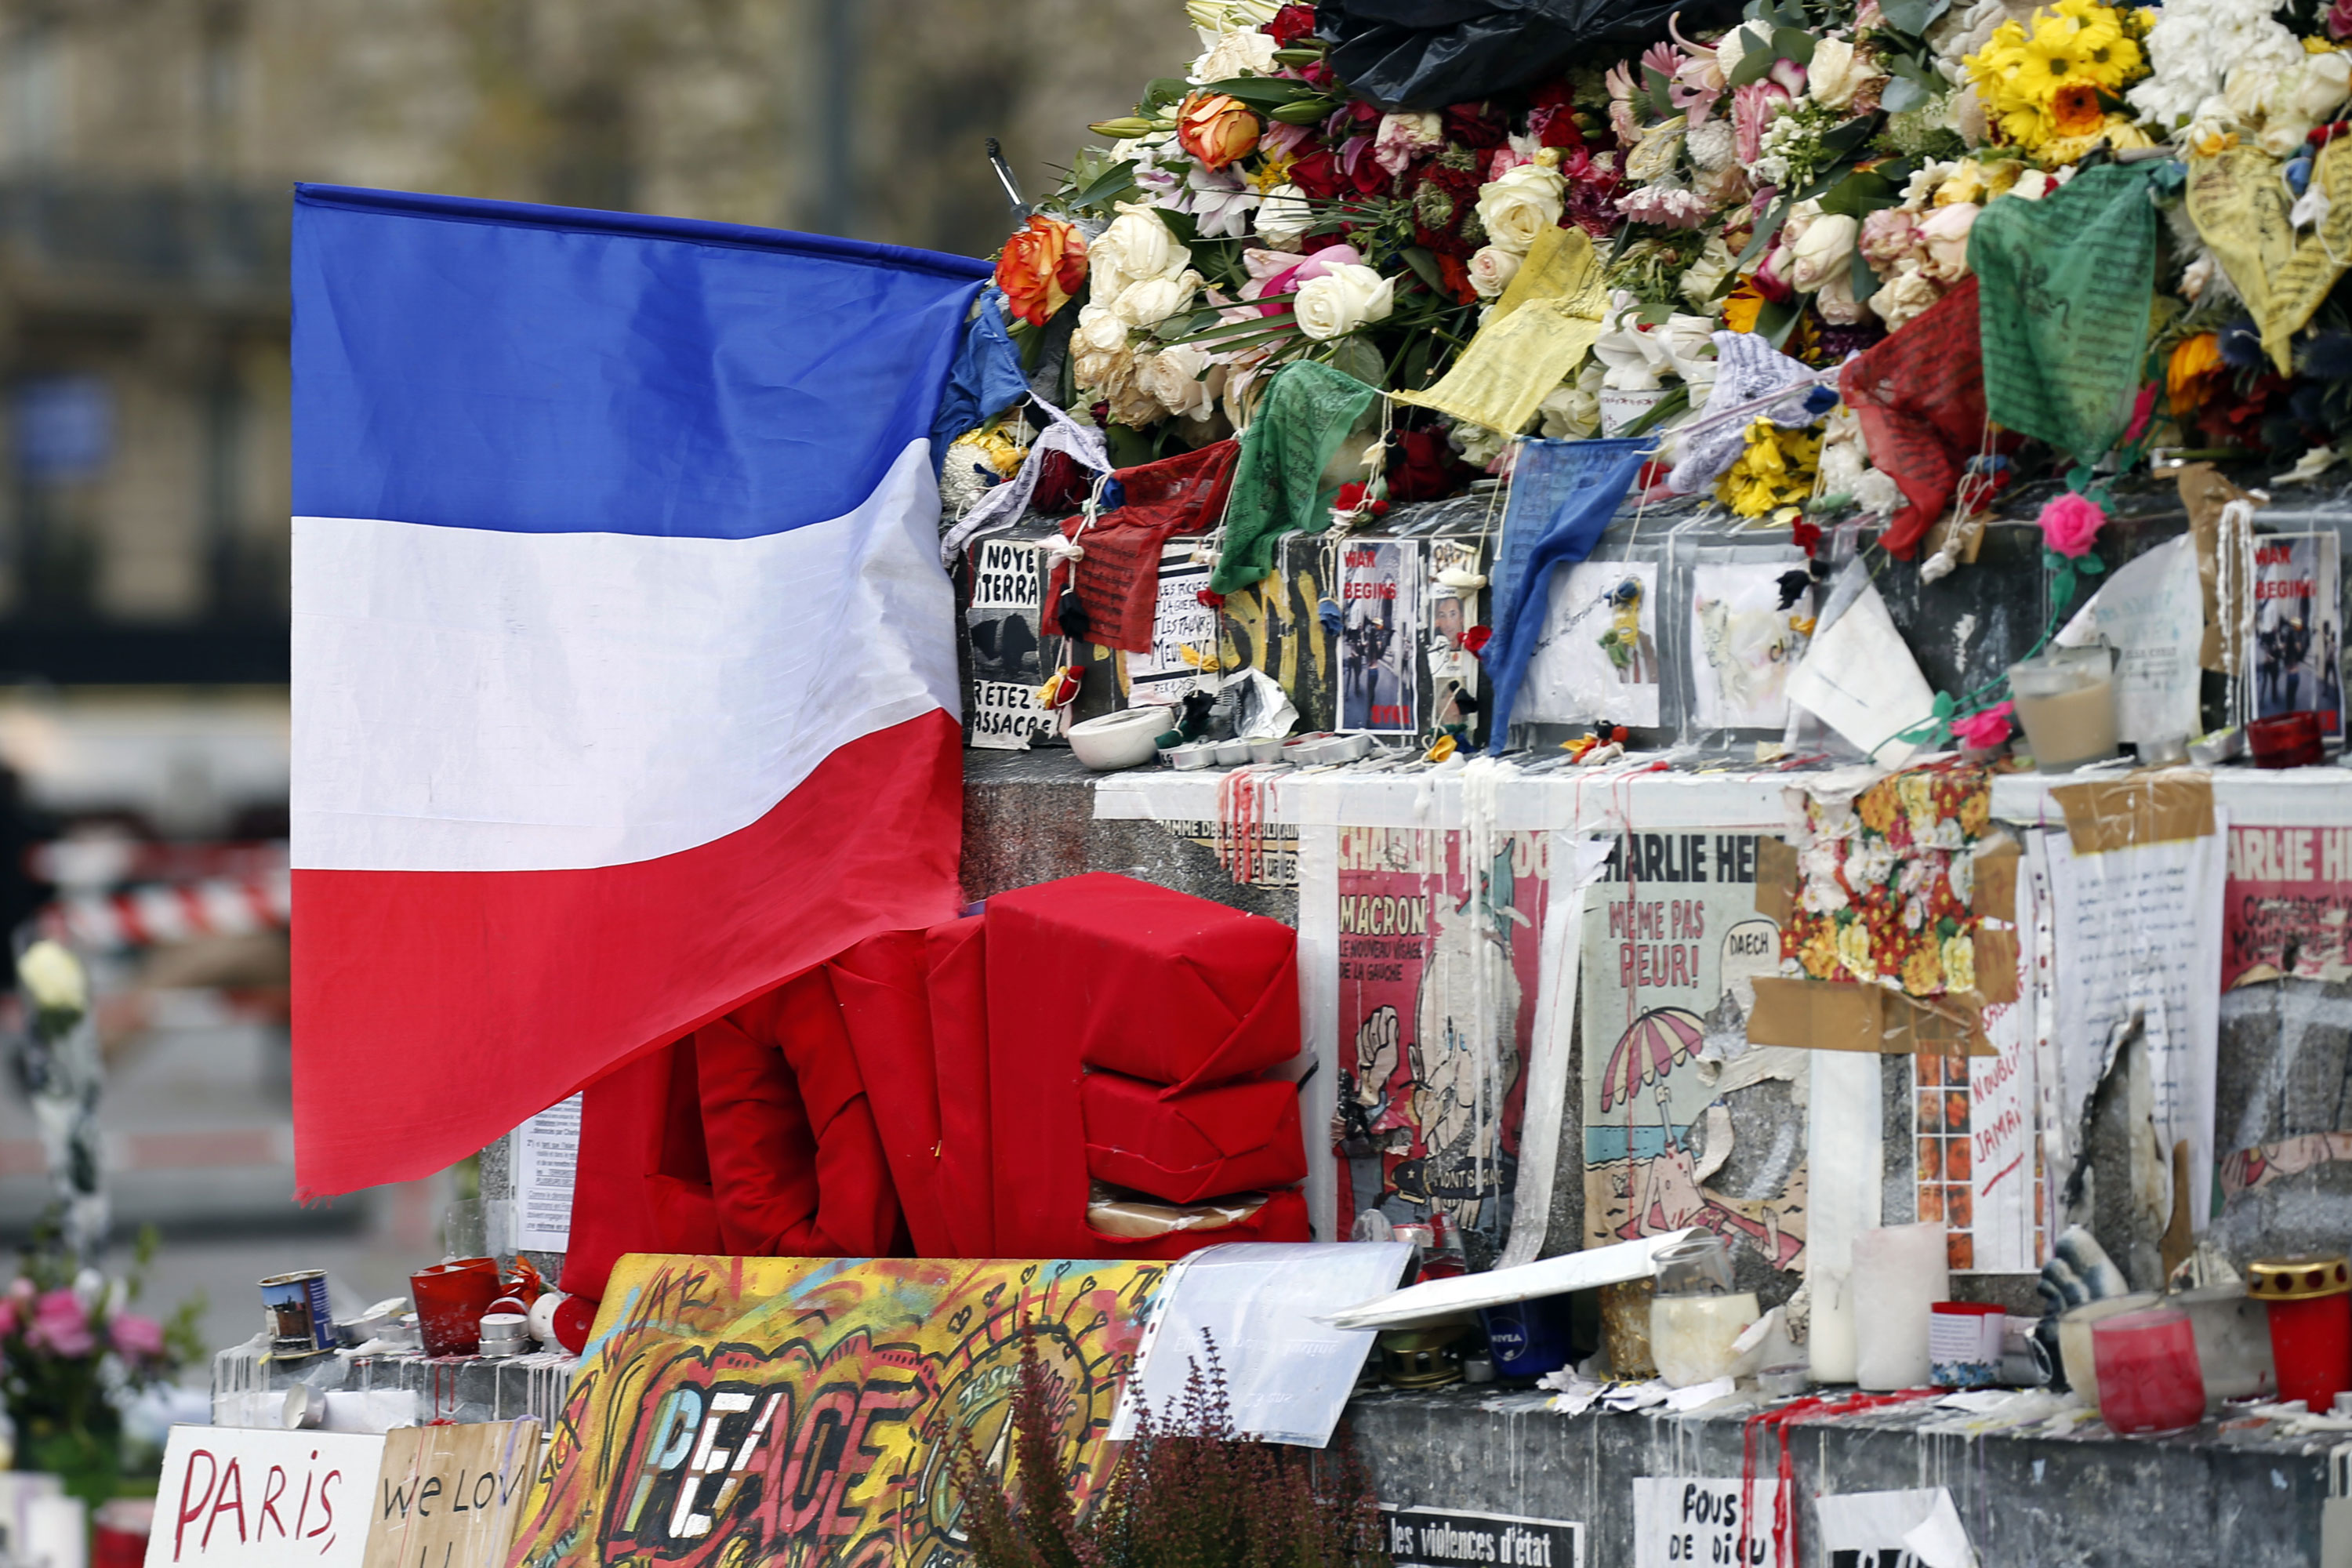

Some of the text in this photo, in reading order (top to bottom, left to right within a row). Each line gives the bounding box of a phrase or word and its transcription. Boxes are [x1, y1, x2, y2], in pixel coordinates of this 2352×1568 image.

[988, 545, 1035, 574] NOYE
[1343, 551, 1377, 568] WAR
[2255, 546, 2292, 565] WAR
[1343, 583, 1397, 600] BEGINS
[2256, 579, 2317, 599] BEGINS
[1338, 826, 1447, 874] CHARLIE
[1339, 895, 1427, 936] MACRON
[1671, 899, 1705, 939] PAS
[1730, 932, 1769, 956] DAECH
[1620, 942, 1699, 989] PEUR!
[1490, 1334, 1523, 1343] NIVEA
[618, 1380, 927, 1546] PEACE
[1682, 1483, 1737, 1527] FOUS
[1391, 1517, 1414, 1555] les
[1420, 1521, 1496, 1563] violences
[1500, 1526, 1552, 1568] d'état
[1669, 1534, 1694, 1562] DE
